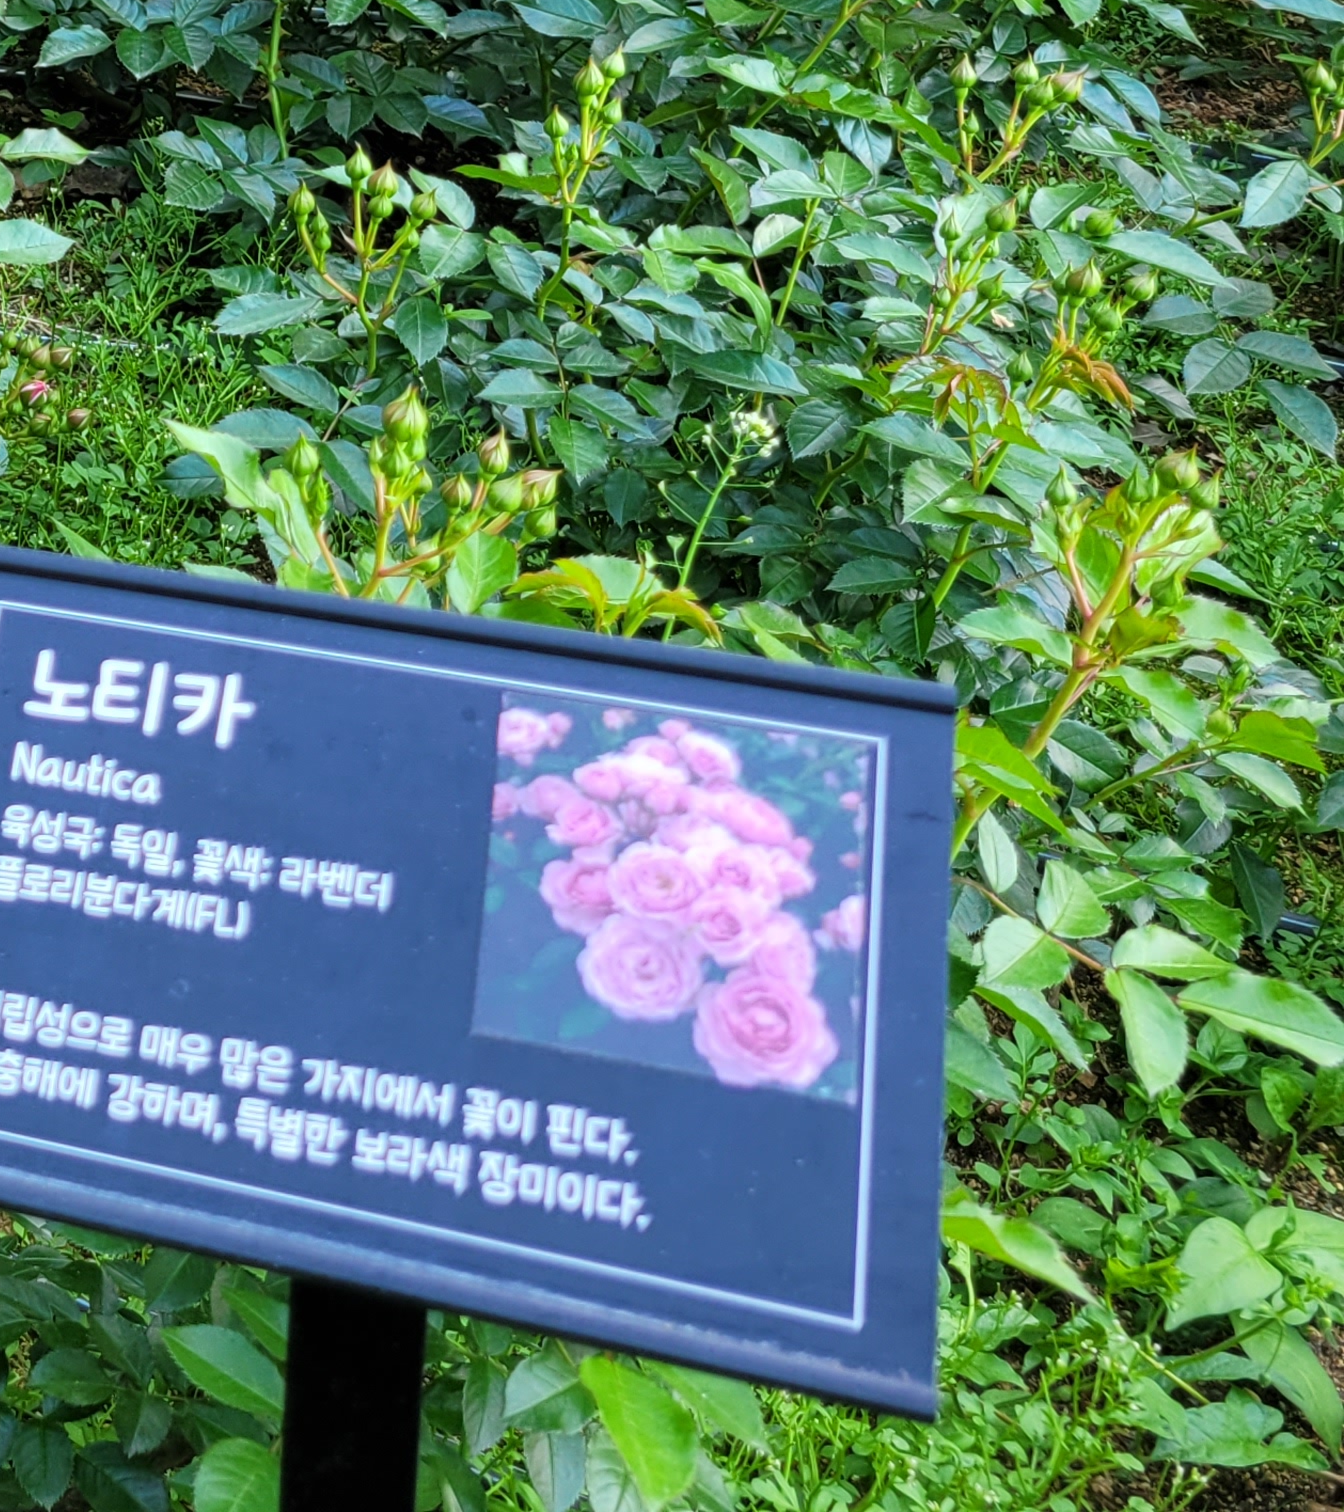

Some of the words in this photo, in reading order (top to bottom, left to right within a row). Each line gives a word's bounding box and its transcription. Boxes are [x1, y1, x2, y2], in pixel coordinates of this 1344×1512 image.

[22, 648, 256, 748] 노티카
[11, 741, 161, 804] Nautica
[1, 804, 106, 860] 육성국:
[110, 823, 186, 878] 독일,
[192, 839, 274, 892] 꽃색:
[279, 856, 393, 913] 라벤더
[139, 1024, 212, 1075] 매우
[219, 1037, 294, 1095] 많은
[302, 1058, 456, 1128] 가지에서
[462, 1087, 539, 1146] 꽃이
[546, 1104, 641, 1167] 핀다.
[107, 1073, 228, 1144] 강하며,
[235, 1097, 349, 1166] 특별한
[352, 1128, 472, 1197] 보라색
[477, 1150, 653, 1232] 장미이다.
